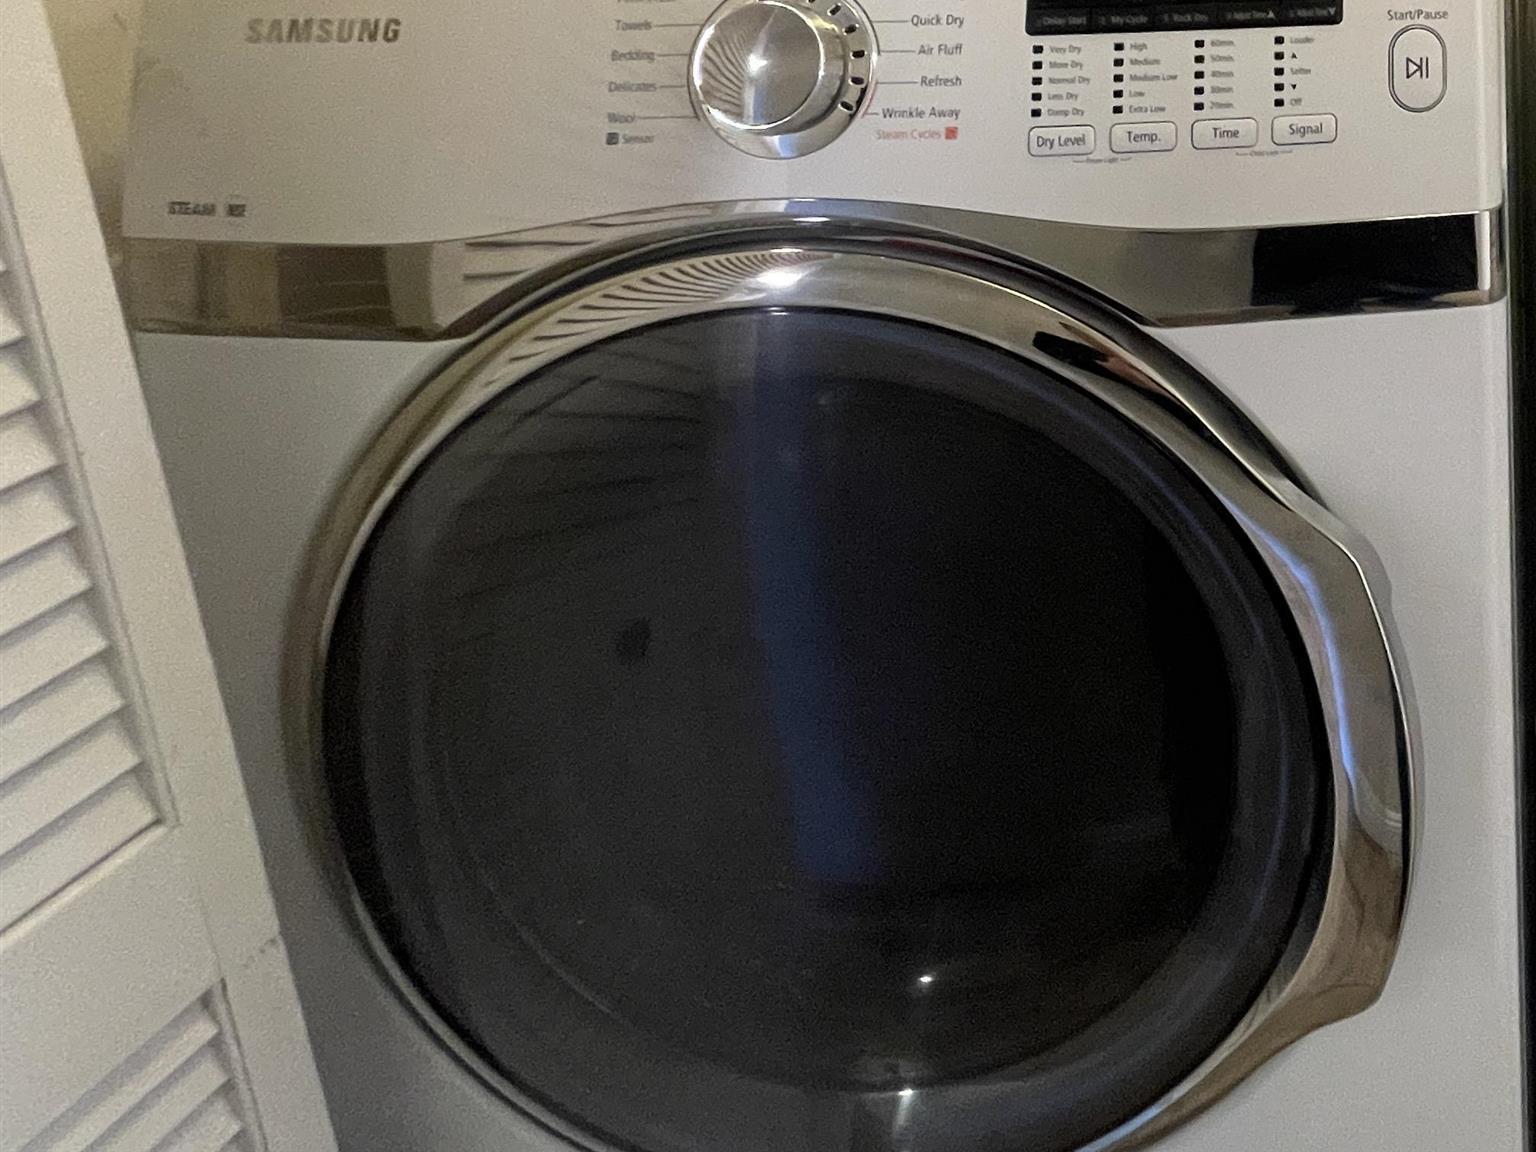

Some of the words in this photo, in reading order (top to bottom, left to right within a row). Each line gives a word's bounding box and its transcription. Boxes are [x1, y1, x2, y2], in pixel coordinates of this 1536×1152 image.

[911, 14, 943, 26] Quick
[945, 14, 965, 28] Dry
[1387, 8, 1449, 21] Start/Pause
[245, 17, 402, 44] SAMSUNG
[918, 44, 934, 56] Air
[937, 42, 963, 55] Fluff
[920, 74, 963, 88] Refresh
[881, 105, 926, 119] Wrinkle
[928, 105, 961, 120] Away
[1127, 130, 1161, 144] Temp.
[1212, 127, 1240, 139] Time
[1288, 122, 1323, 138] Signal
[1036, 135, 1055, 150] Dry
[1058, 133, 1086, 148] Level
